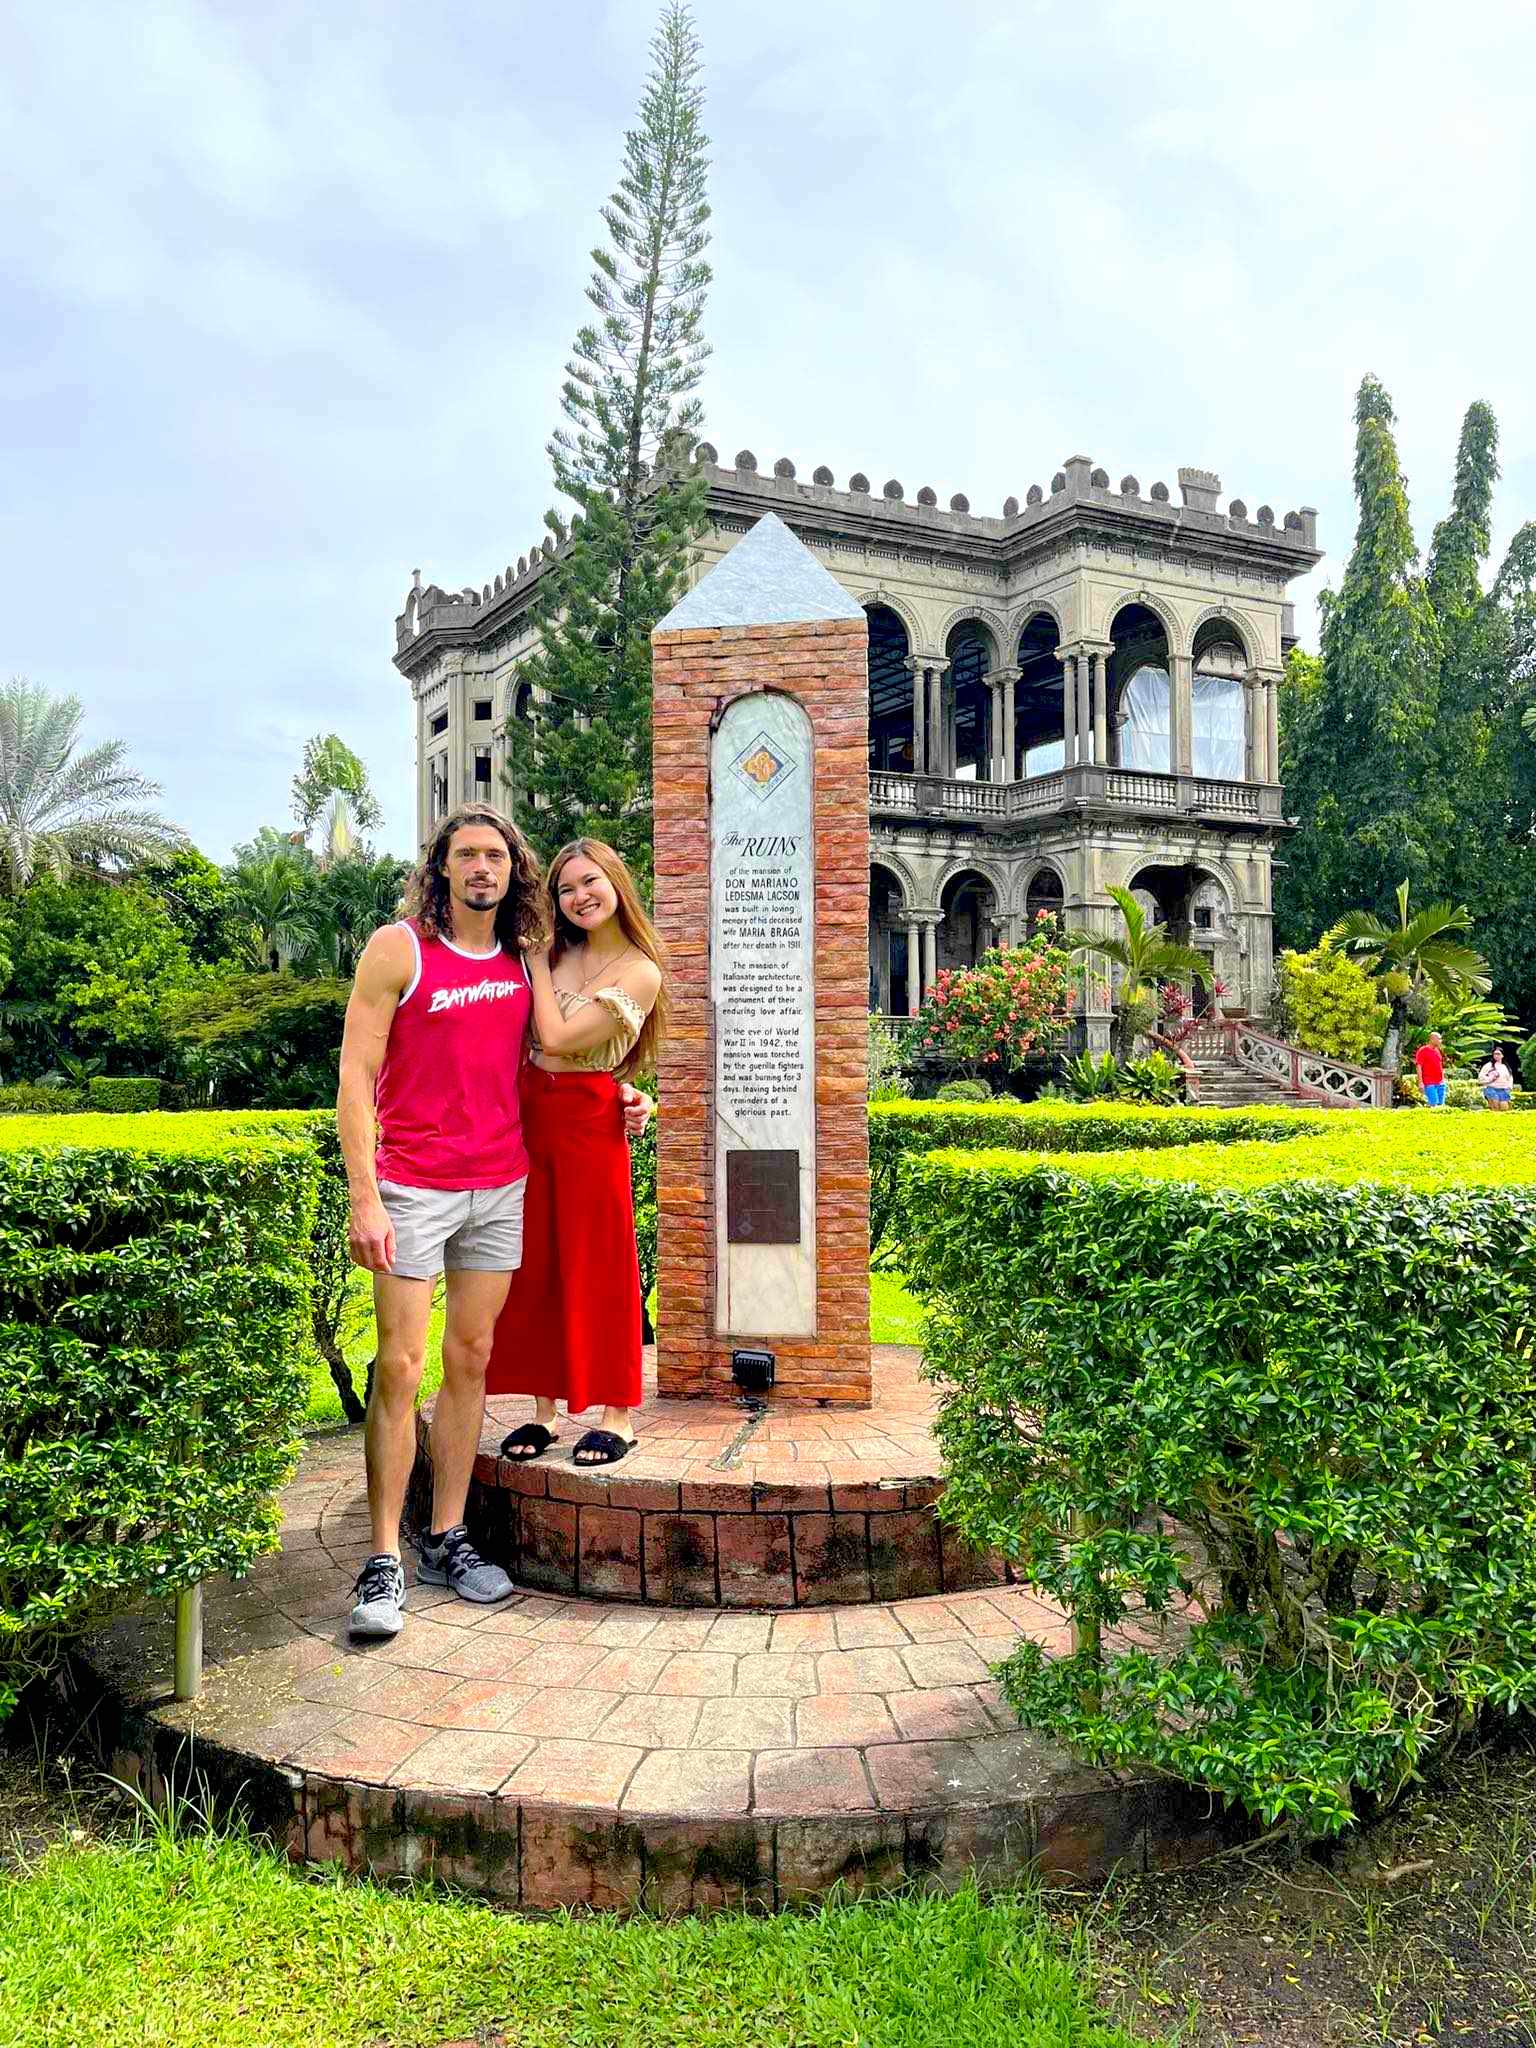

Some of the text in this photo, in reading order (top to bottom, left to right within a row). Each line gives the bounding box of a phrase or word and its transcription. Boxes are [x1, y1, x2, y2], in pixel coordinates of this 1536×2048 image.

[741, 836, 801, 857] RUINS
[726, 878, 798, 888] DON MARIANO
[725, 891, 800, 901] LEDESMA LACSON
[772, 905, 794, 914] loving
[740, 928, 766, 937] MARIA
[771, 928, 800, 937] BRAGA
[740, 985, 772, 994] designed
[427, 979, 523, 1012] BAYWATCH
[723, 1008, 755, 1017] enduring
[778, 1063, 804, 1071] fighters
[743, 1086, 769, 1094] leaving
[735, 1109, 766, 1117] glorious
